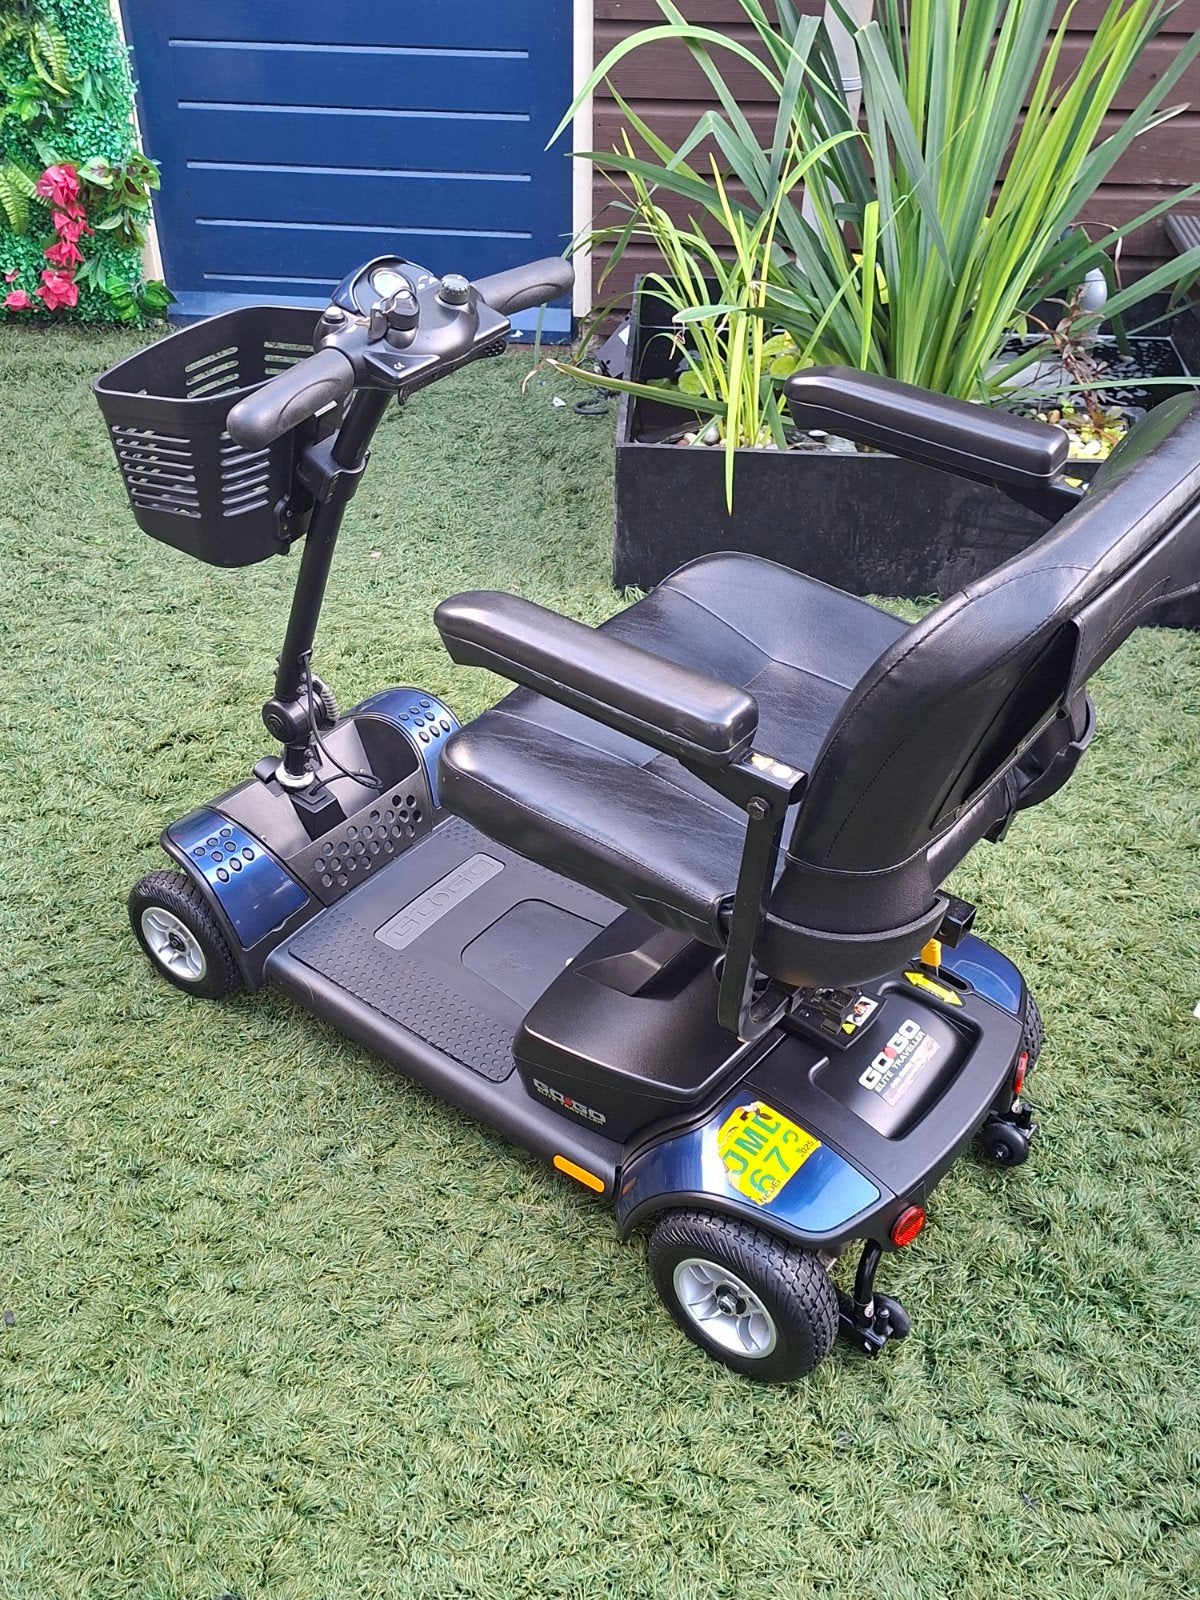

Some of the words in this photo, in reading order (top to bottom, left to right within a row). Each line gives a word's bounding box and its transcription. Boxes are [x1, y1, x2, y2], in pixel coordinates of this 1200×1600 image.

[874, 1067, 895, 1093] ELITE
[892, 1032, 926, 1071] TRAVELLER
[800, 1140, 814, 1158] 025
